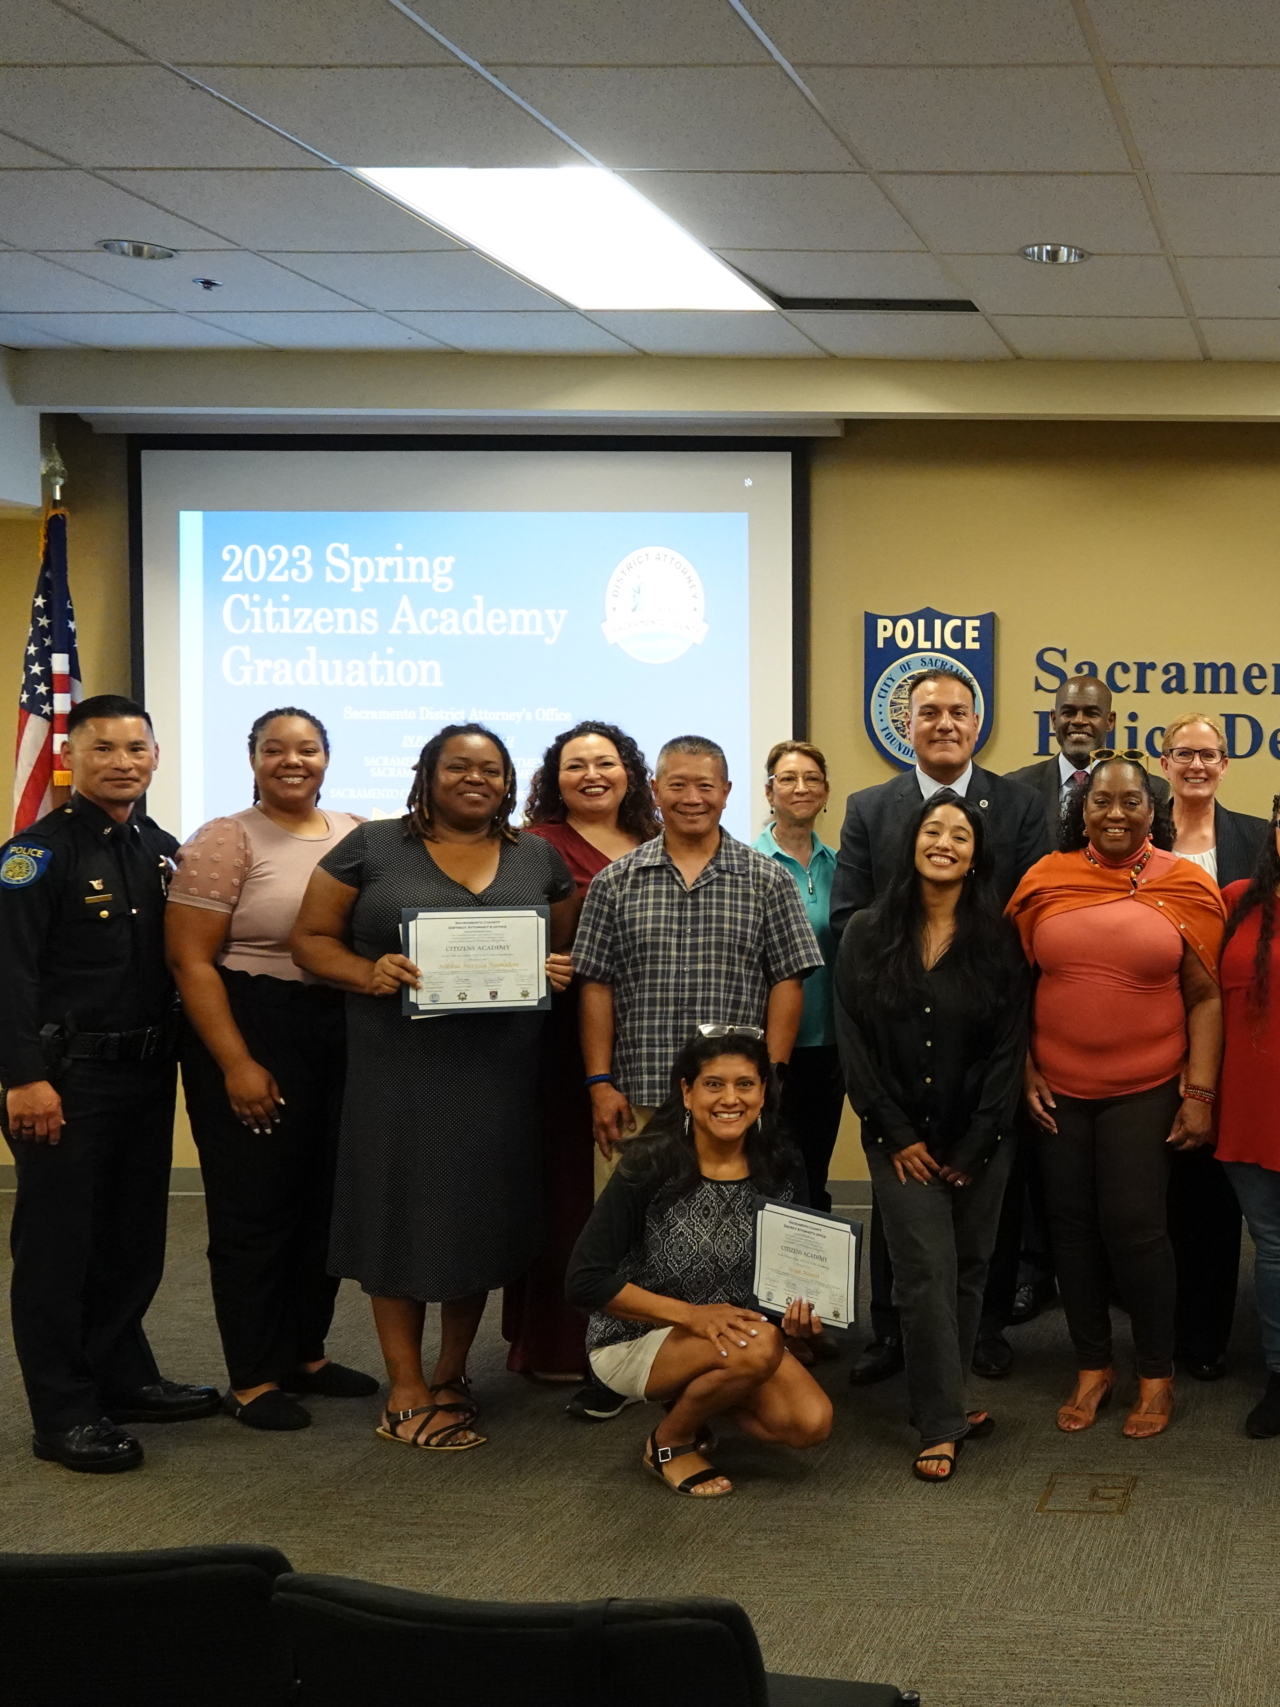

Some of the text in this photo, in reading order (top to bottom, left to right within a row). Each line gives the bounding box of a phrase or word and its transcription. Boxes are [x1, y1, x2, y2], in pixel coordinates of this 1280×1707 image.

[221, 543, 454, 592] 2023 Spring
[612, 553, 699, 599] DISTRICT ATTORNEY
[222, 594, 567, 645] Citizens Academy
[877, 618, 980, 650] POLICE
[221, 646, 443, 687] Graduation
[877, 673, 896, 699] CITY
[899, 660, 913, 674] OF
[343, 706, 572, 723] Sacramento District Attorney's Office
[881, 725, 916, 759] FOUNDE
[330, 789, 399, 798] SACRAMENTO
[10, 846, 45, 858] POLICE
